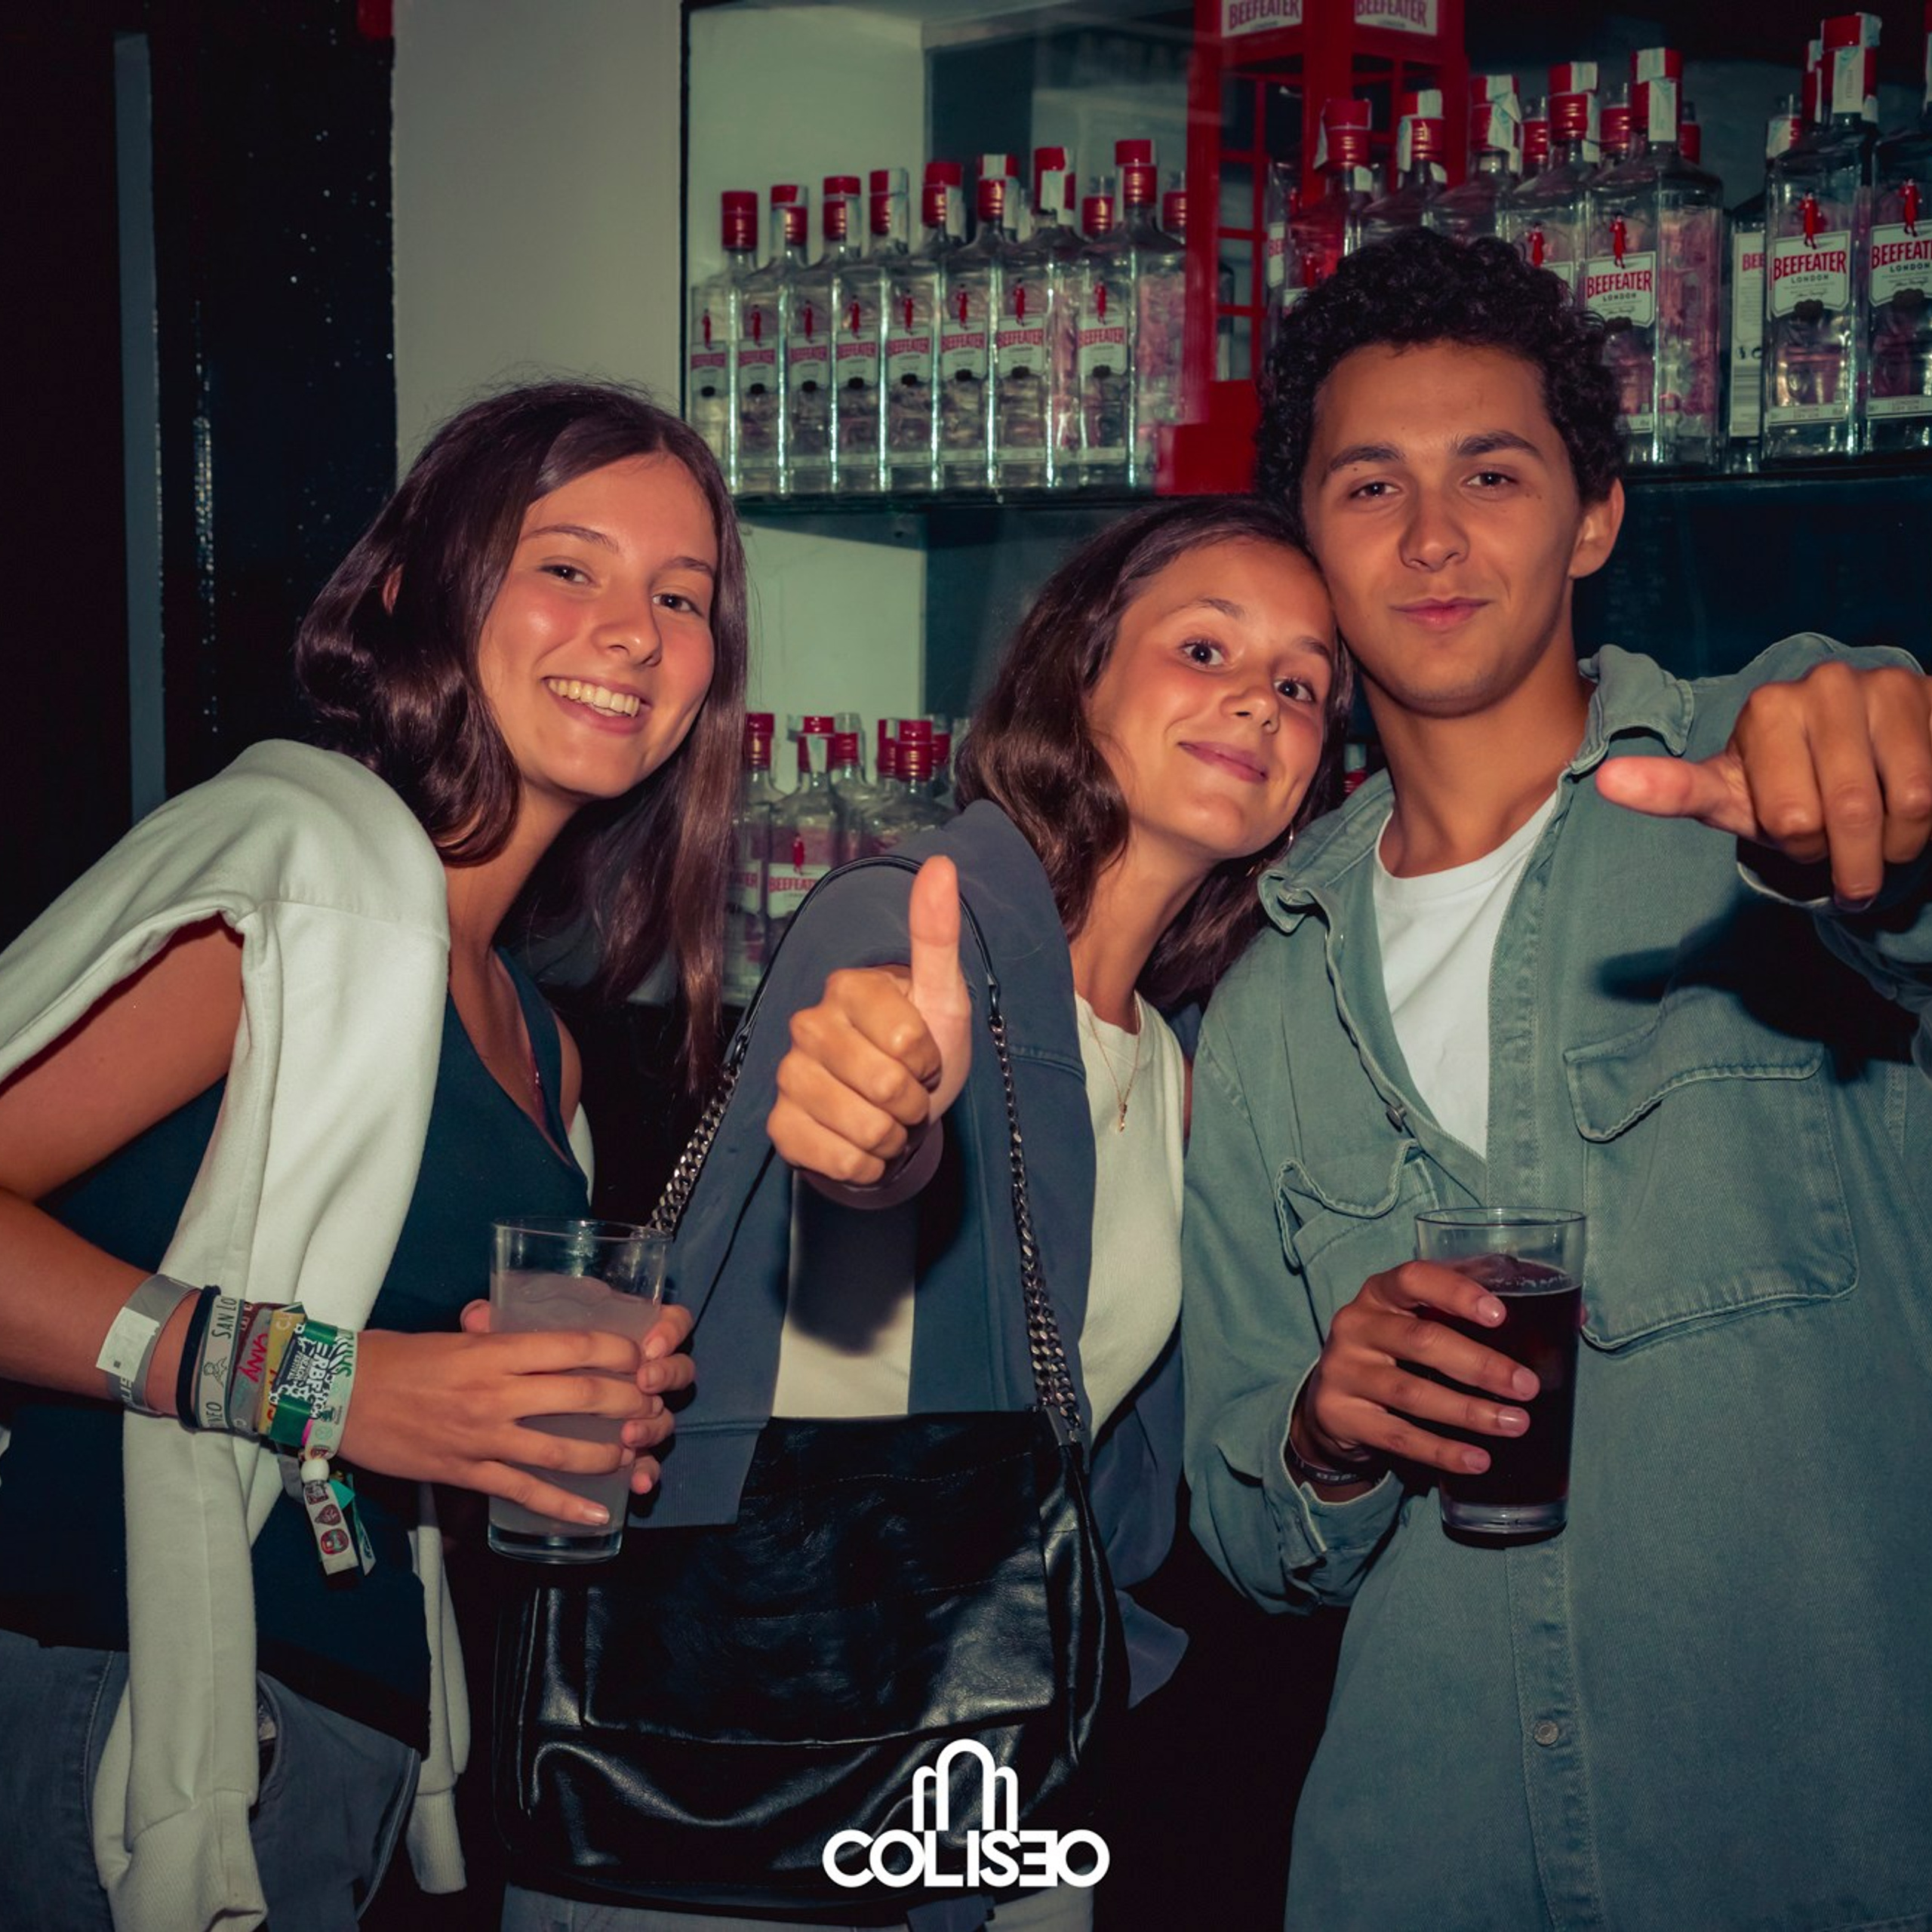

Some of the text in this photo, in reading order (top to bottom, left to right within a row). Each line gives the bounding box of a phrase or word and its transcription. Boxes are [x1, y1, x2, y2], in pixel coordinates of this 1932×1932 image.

[1229, 0, 1300, 30] BEEFEATER
[1356, 0, 1427, 28] BEEFEATER
[1774, 251, 1847, 281] BEEFEATER
[1872, 238, 1932, 270] BEEFEAT
[1890, 262, 1930, 273] LONDON
[1586, 270, 1652, 299] BEEFEATER
[1791, 274, 1829, 284] LONDON
[1603, 293, 1636, 302] LONDON
[211, 1313, 235, 1340] SAN
[306, 1353, 331, 1393] RBF
